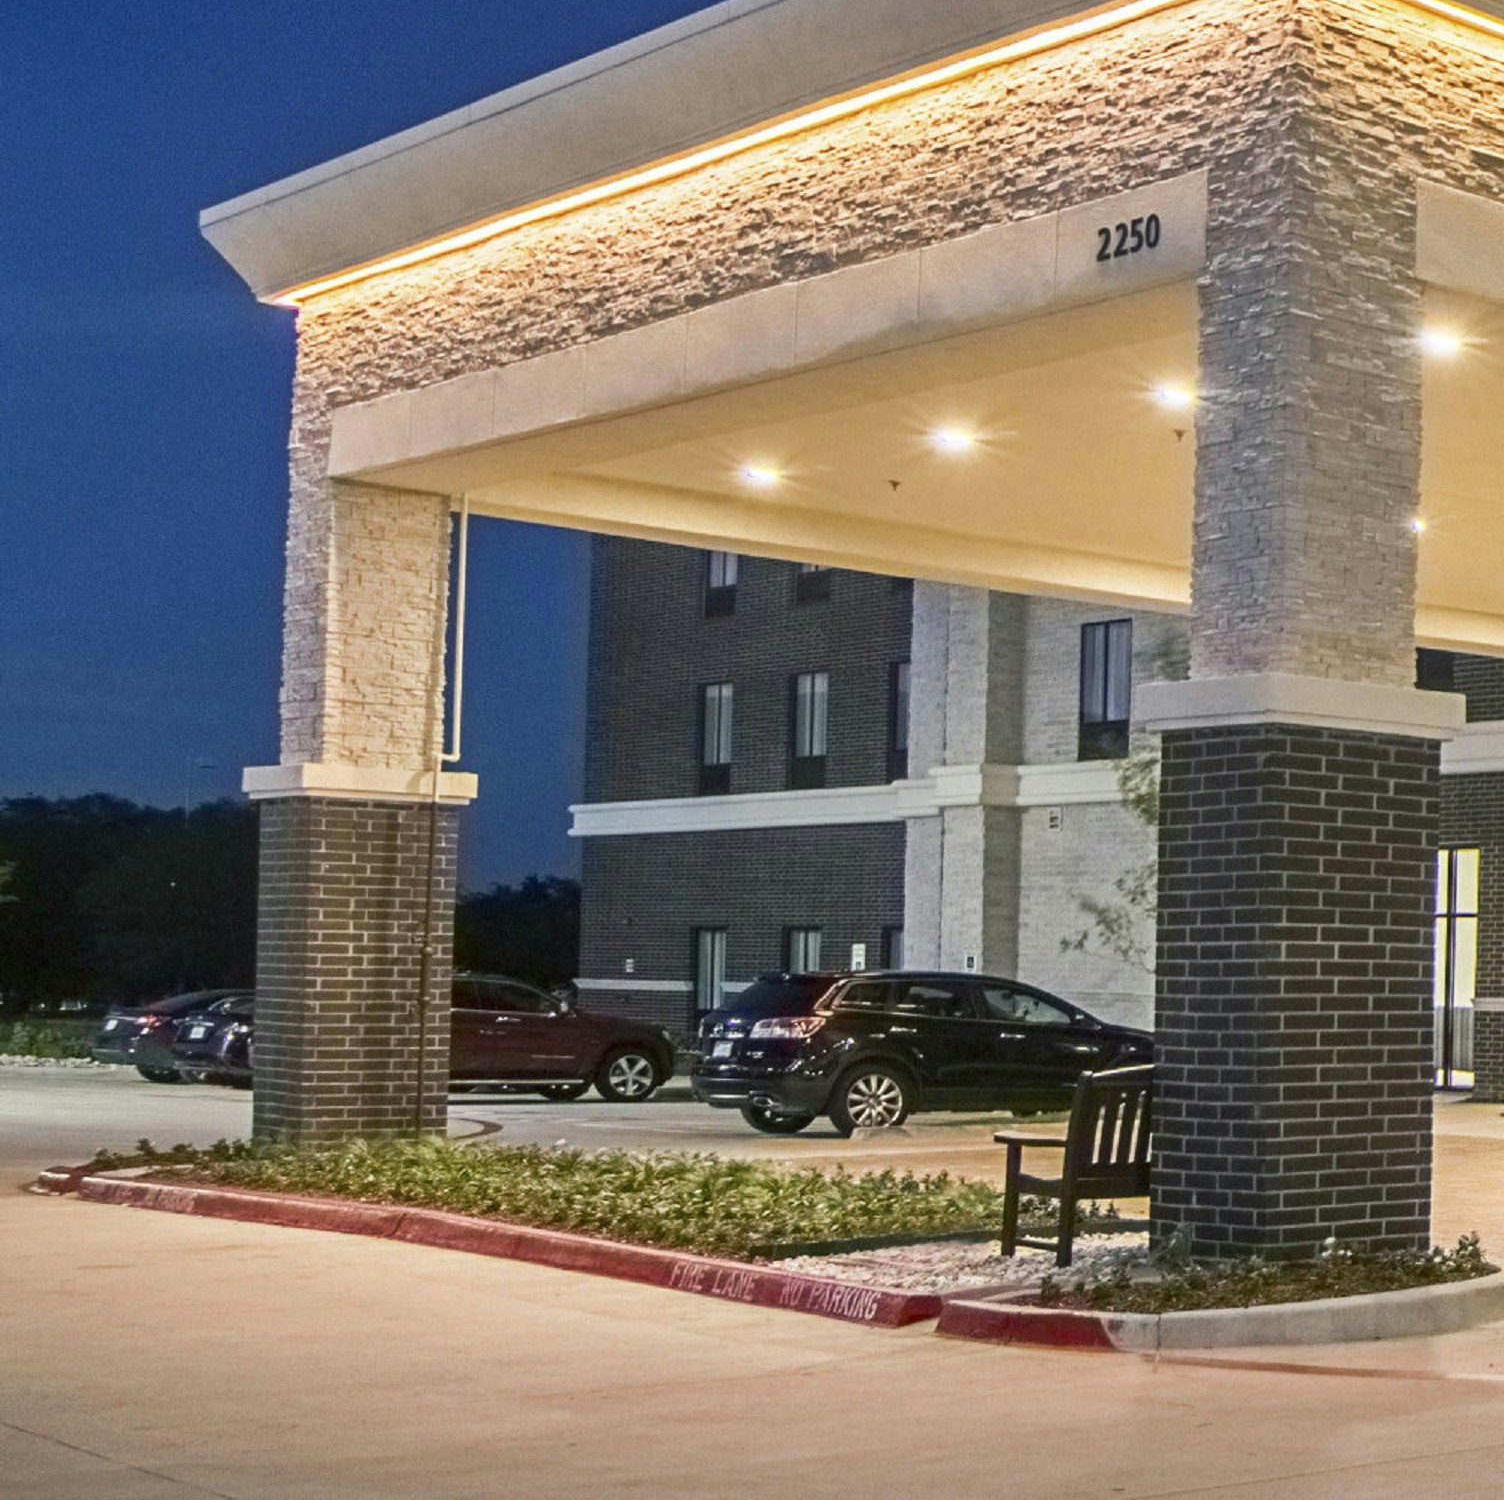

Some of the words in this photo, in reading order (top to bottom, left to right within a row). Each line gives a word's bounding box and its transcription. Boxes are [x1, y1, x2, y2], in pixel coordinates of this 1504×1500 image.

[1096, 213, 1162, 262] 2250
[670, 1262, 705, 1290] FIRE
[712, 1269, 756, 1301] LANE
[781, 1279, 803, 1306] NO
[805, 1282, 882, 1321] PARKING
